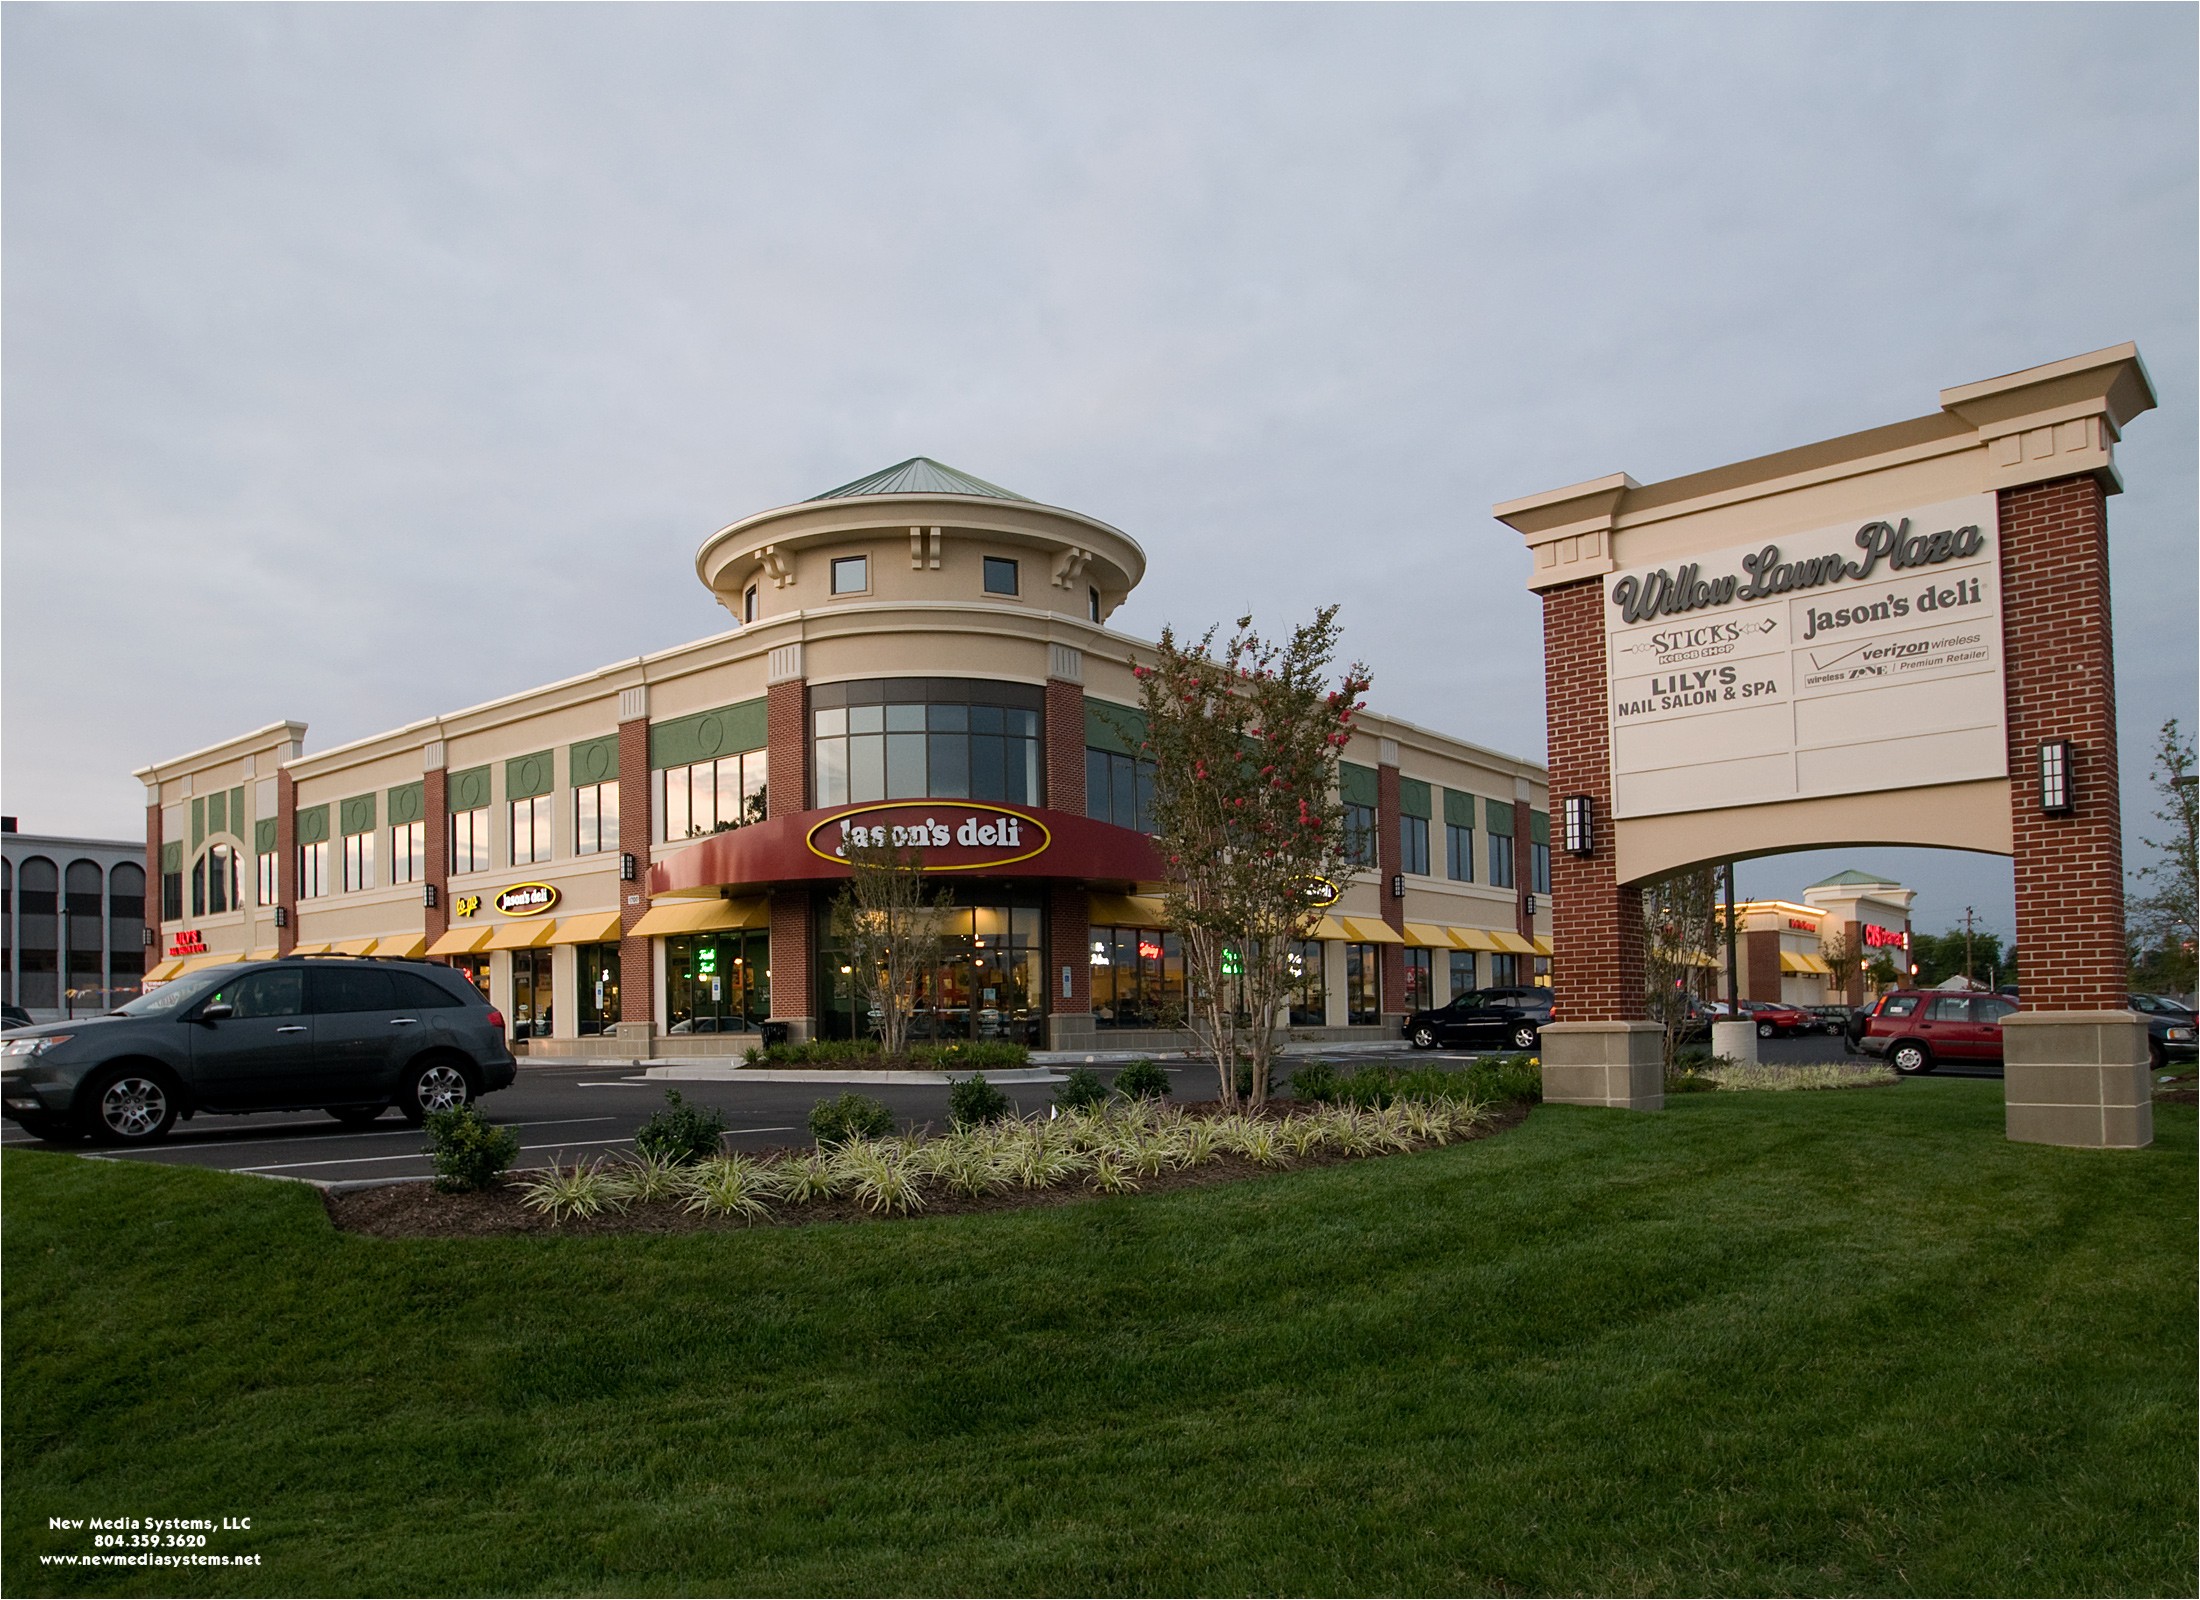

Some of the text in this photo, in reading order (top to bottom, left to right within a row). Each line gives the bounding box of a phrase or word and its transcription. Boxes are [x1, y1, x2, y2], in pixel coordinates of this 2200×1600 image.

[1612, 517, 1984, 625] Willow Lawn Plaza
[1803, 577, 1982, 640] Jason's deli
[1651, 620, 1741, 656] STICKS
[1862, 633, 1981, 661] verizon wireless
[1652, 665, 1737, 696] LILY'S
[1807, 671, 1845, 685] wireless
[1900, 656, 1943, 671] Premium
[1946, 649, 1987, 662] Retailer
[1618, 680, 1777, 717] NAIL SALON & SPA
[835, 817, 1021, 857] Jason's deli
[502, 888, 548, 911] Jason's deli
[1864, 923, 1883, 948] CVS
